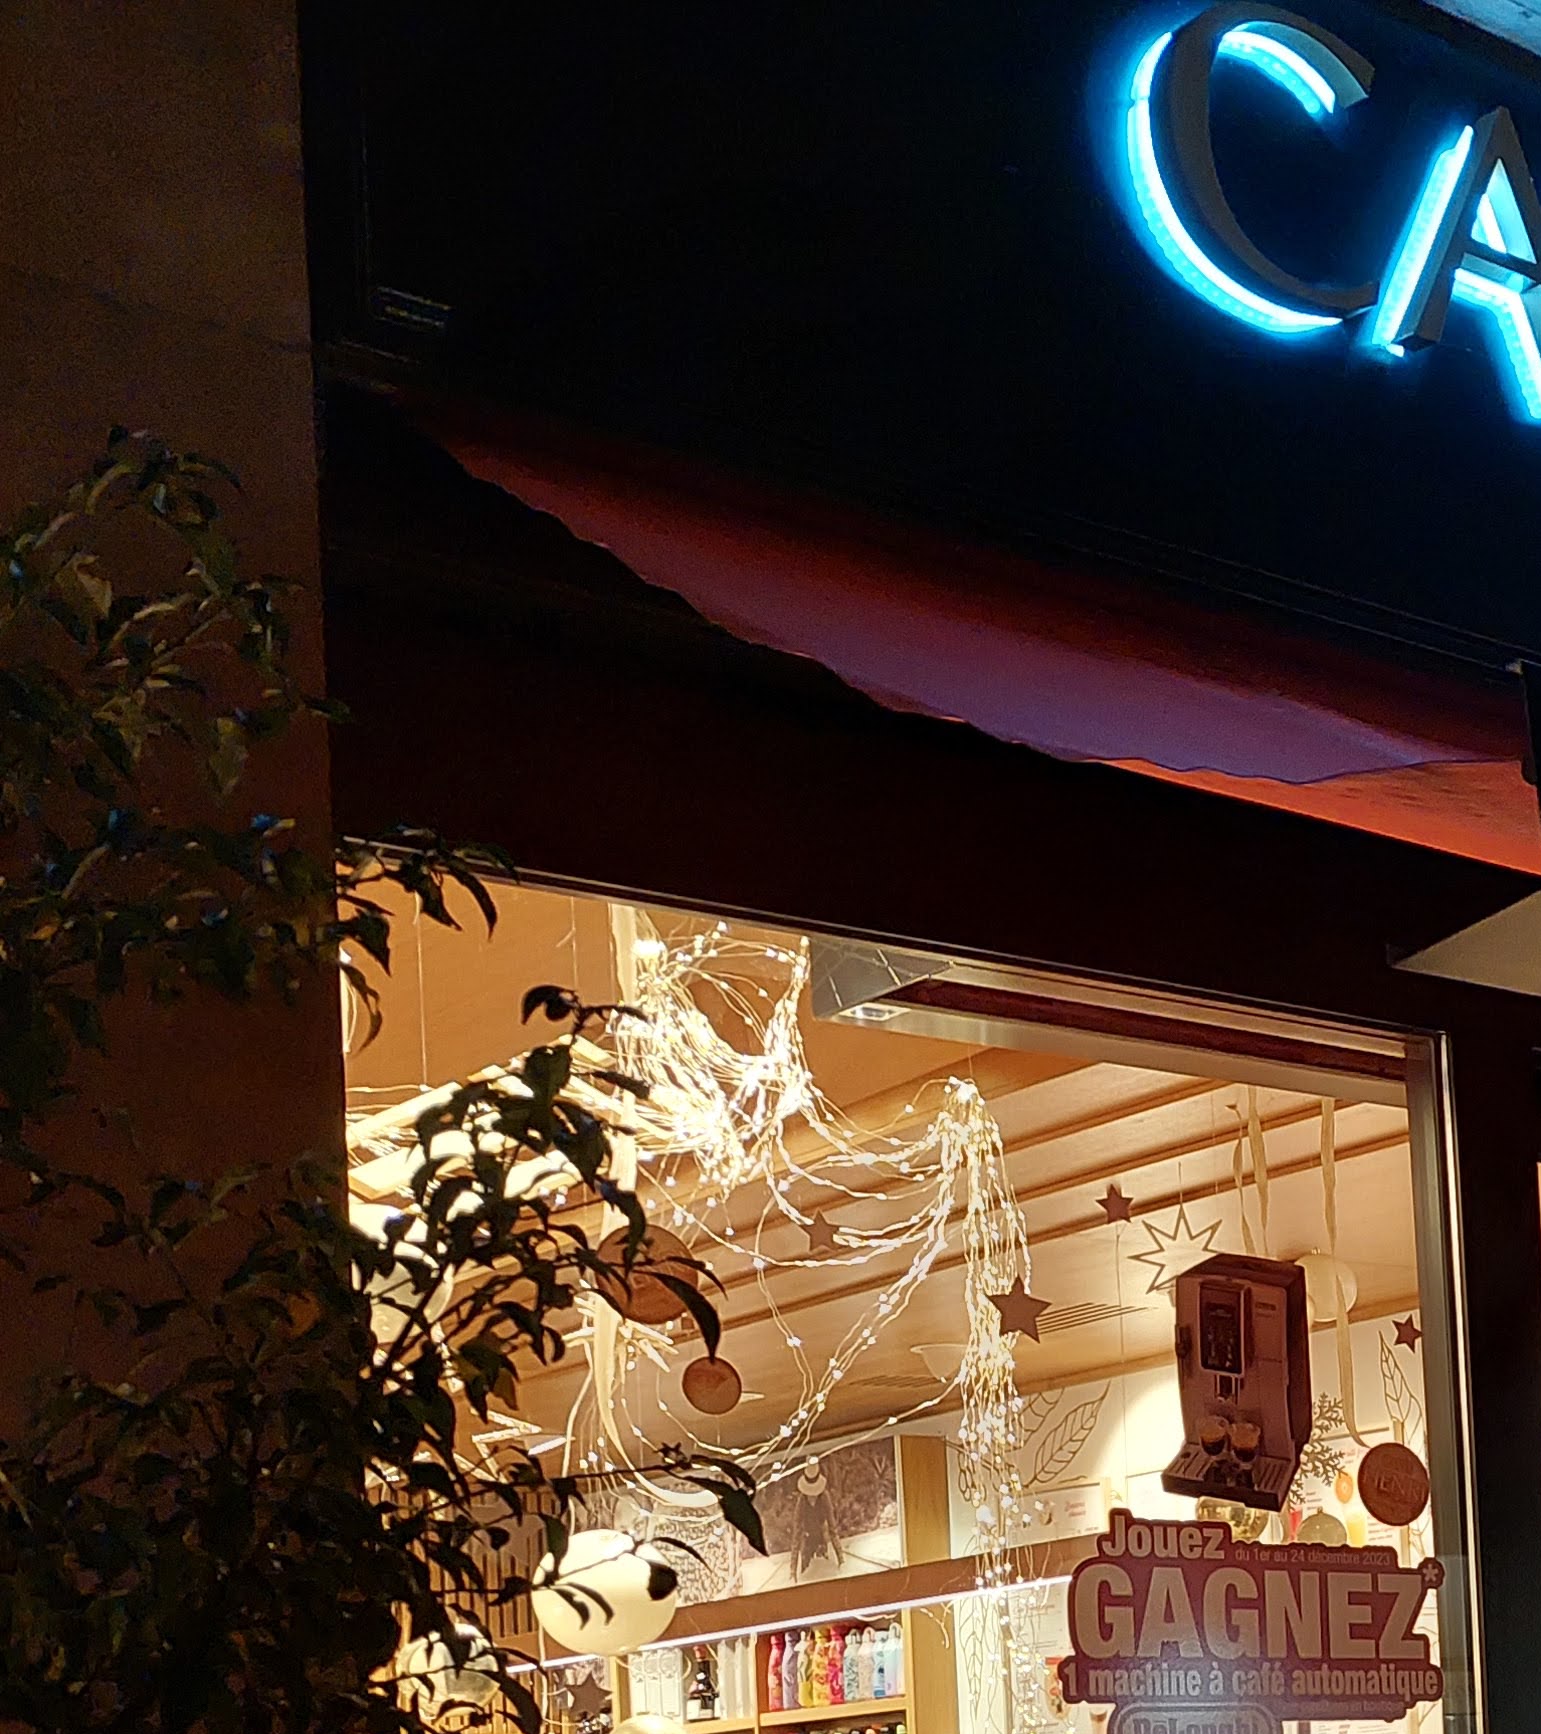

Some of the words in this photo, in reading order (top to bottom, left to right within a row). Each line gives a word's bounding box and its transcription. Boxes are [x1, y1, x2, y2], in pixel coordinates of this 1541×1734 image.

[1101, 1515, 1225, 1560] Jouez
[1235, 1548, 1250, 1562] du
[1254, 1548, 1270, 1562] 1er
[1274, 1551, 1287, 1563] au
[1308, 1550, 1360, 1564] décembre
[1363, 1551, 1393, 1565] 2023
[1064, 1664, 1078, 1696] 1
[1089, 1661, 1201, 1697] machine
[1210, 1660, 1223, 1696] à
[1231, 1663, 1286, 1697] café
[1291, 1664, 1438, 1701] automatique
